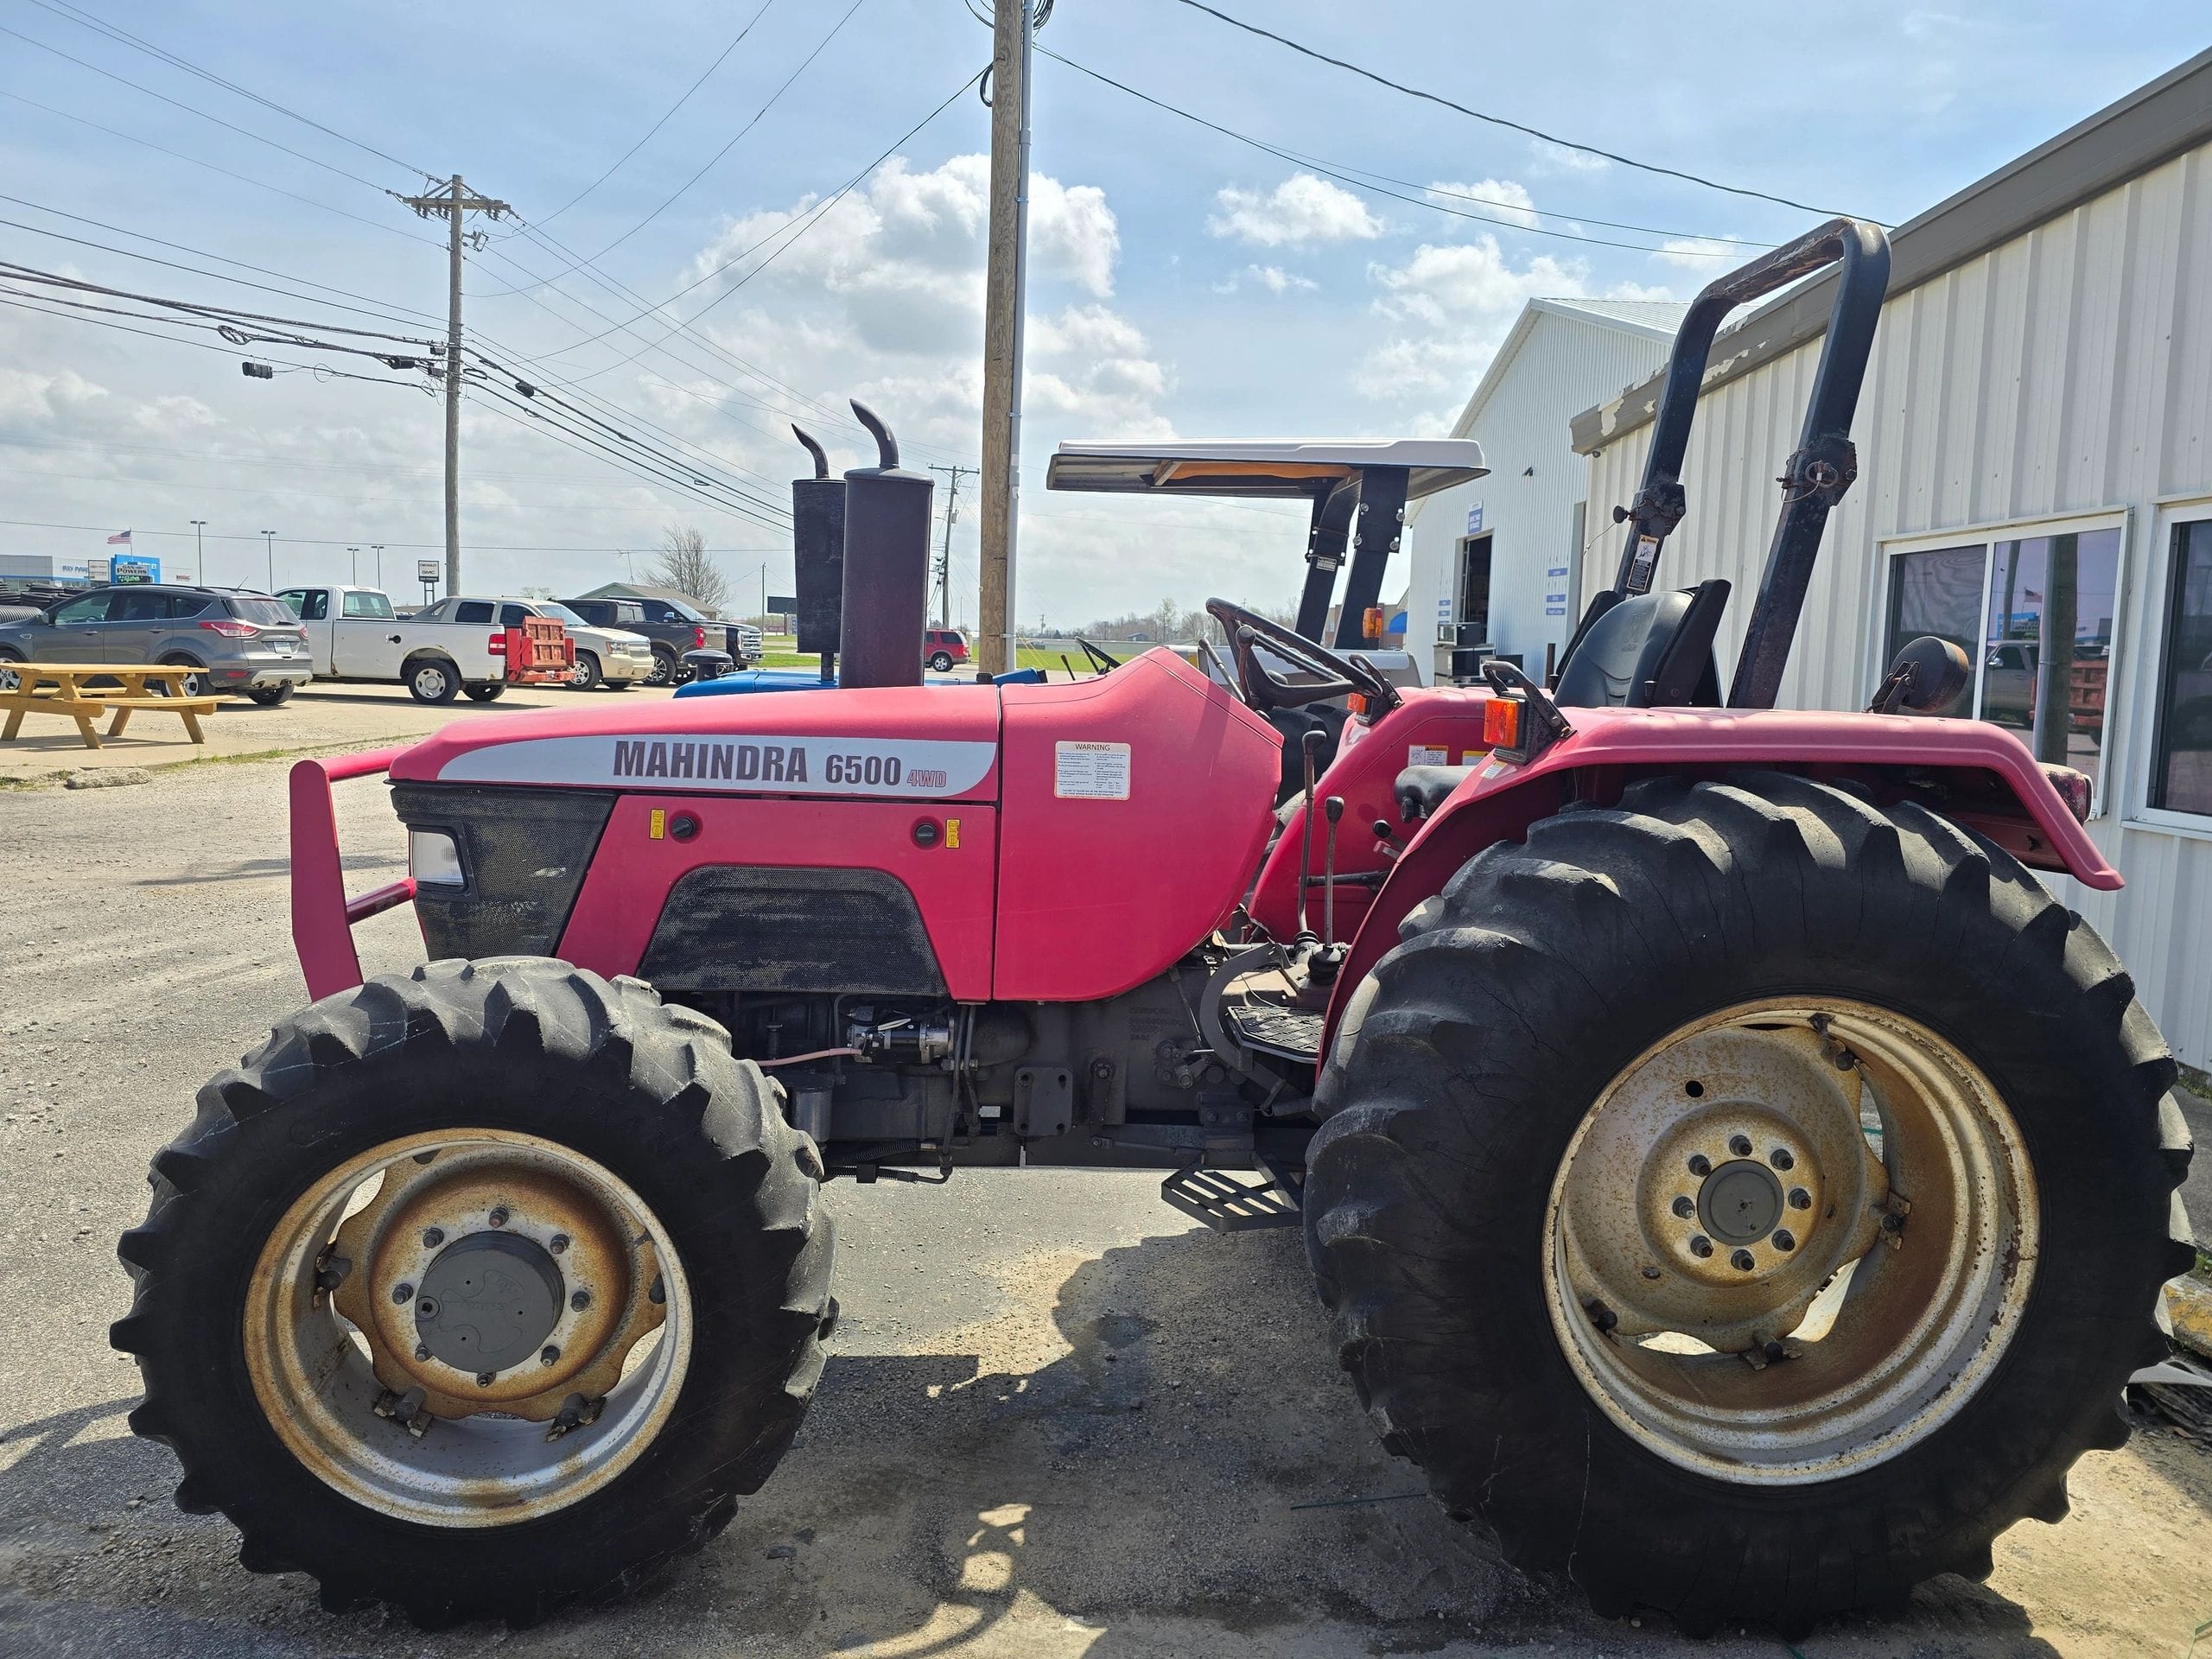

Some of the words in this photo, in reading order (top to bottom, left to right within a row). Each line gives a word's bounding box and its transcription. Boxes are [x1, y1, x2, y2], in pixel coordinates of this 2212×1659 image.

[1076, 743, 1110, 752] WARNING
[613, 741, 808, 783] MAHINDRA
[825, 754, 901, 786] 6500
[906, 768, 947, 788] 4WD
